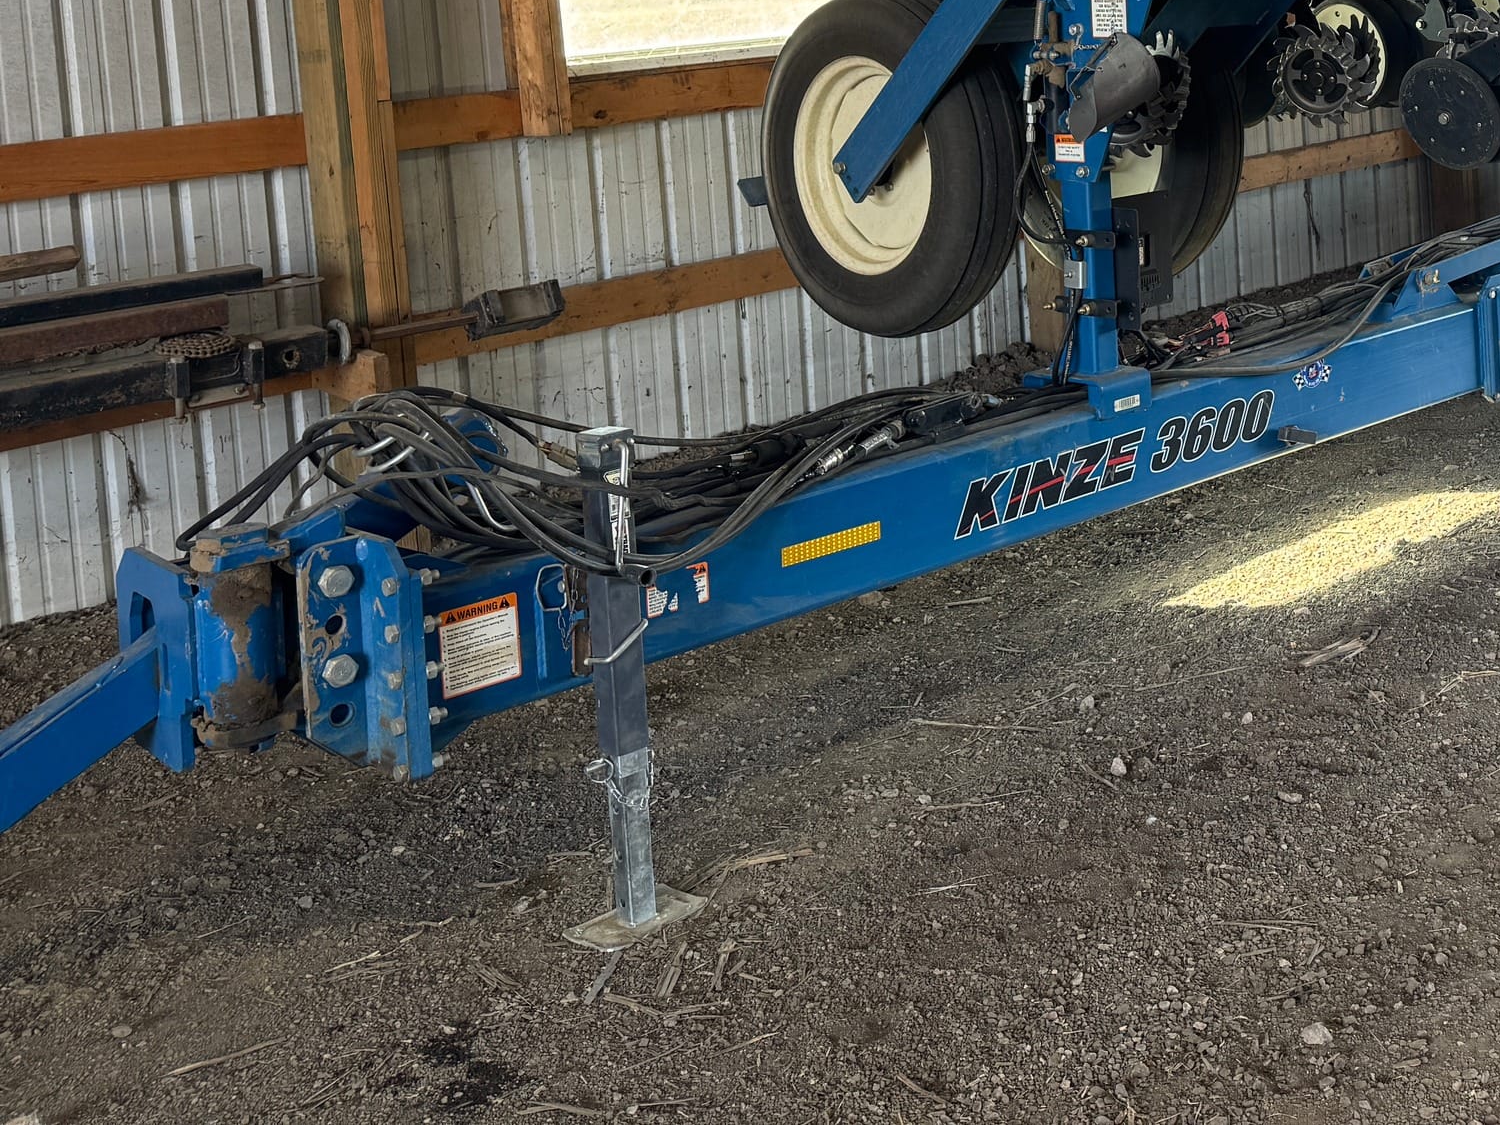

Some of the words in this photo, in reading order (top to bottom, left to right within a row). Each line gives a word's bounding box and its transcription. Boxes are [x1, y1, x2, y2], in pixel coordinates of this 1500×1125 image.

[954, 427, 1146, 541] KINZE
[1150, 389, 1275, 473] 3600
[456, 601, 498, 620] WARNING
